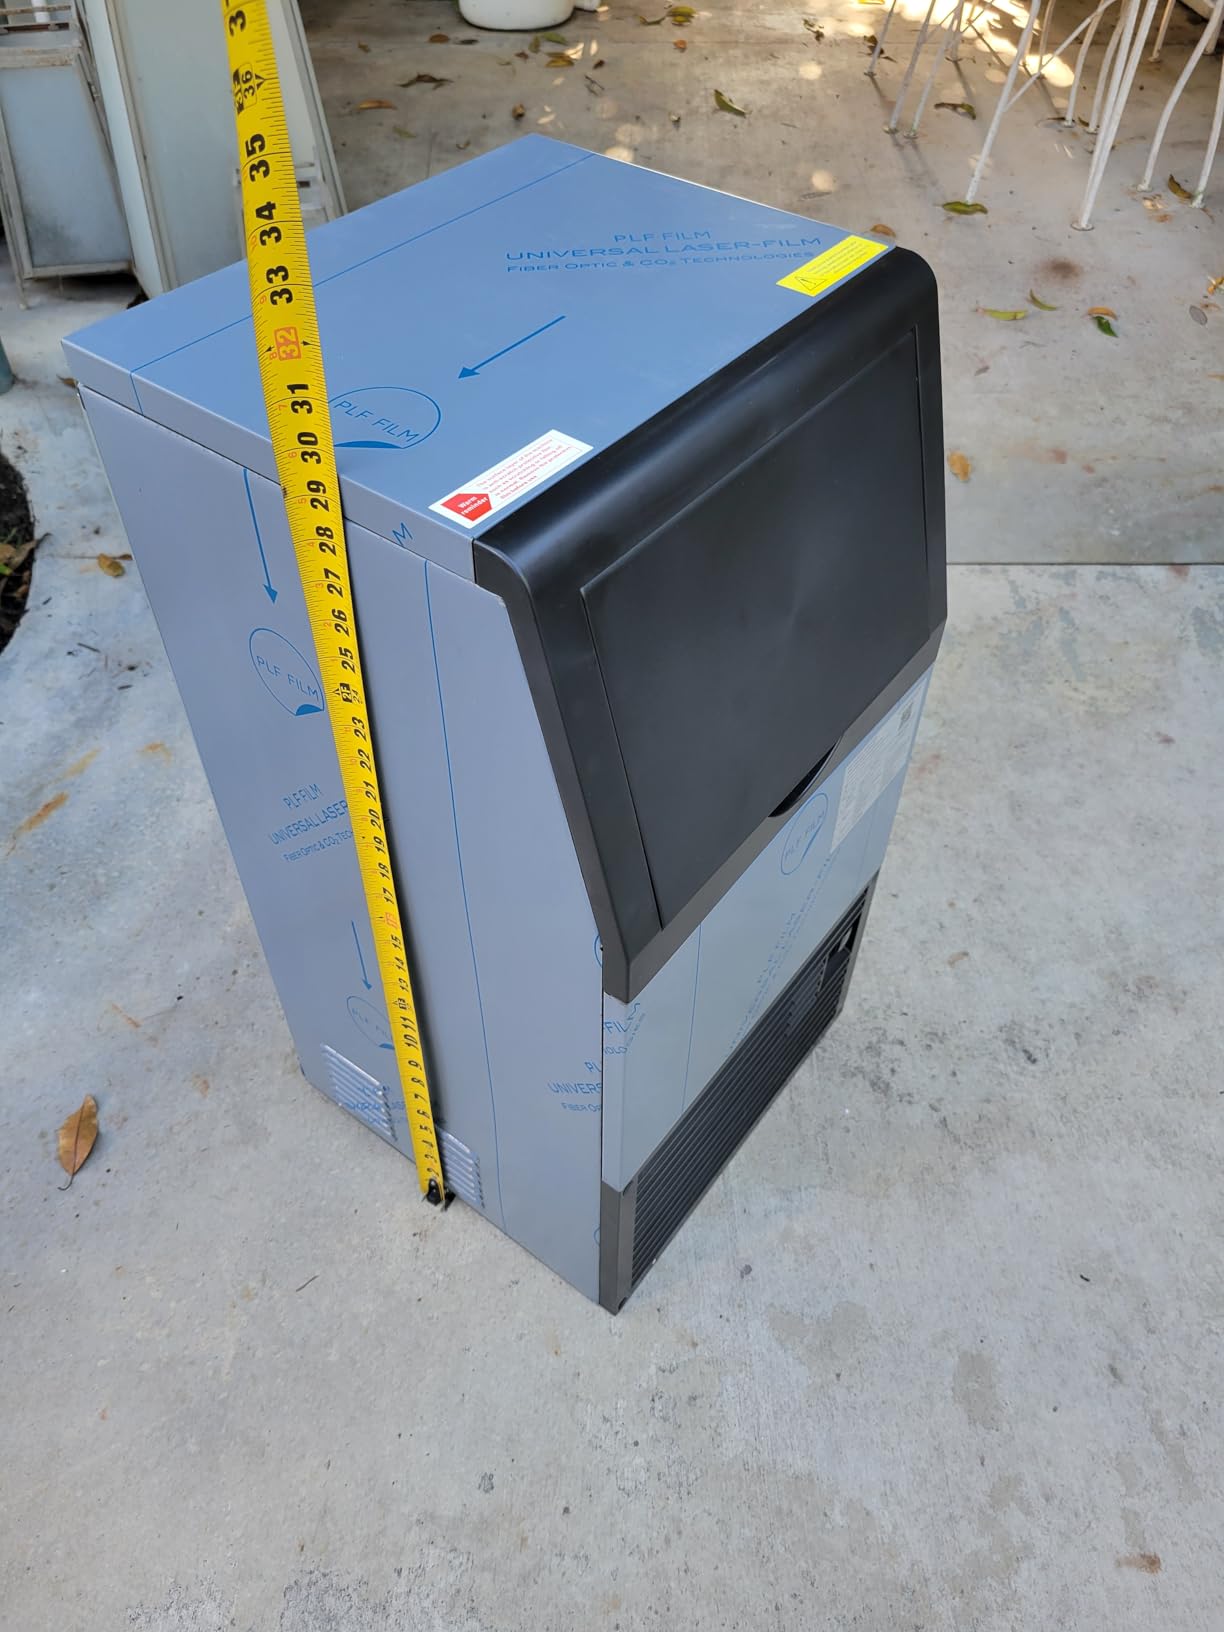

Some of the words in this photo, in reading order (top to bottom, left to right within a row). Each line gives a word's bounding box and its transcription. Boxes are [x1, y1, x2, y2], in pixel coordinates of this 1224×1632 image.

[226, 0, 247, 37] 3
[241, 70, 255, 99] 36
[245, 133, 270, 182] 35
[255, 201, 282, 246] 34
[507, 246, 659, 260] UNIVERSAL
[664, 238, 821, 253] LASER-FILM
[614, 233, 656, 243] PLF
[662, 231, 711, 241] FILM
[507, 264, 559, 273] FIBER
[565, 261, 617, 270] OPTIC
[680, 251, 815, 265] TECHNOLOGIES
[266, 265, 293, 305] 33
[279, 327, 298, 358] 32
[287, 384, 312, 415] 31
[333, 400, 374, 418] PLF
[371, 418, 419, 443] FILM
[297, 431, 321, 465] 30
[307, 480, 330, 512] 29
[457, 496, 477, 508] Warm
[461, 497, 488, 515] reminder
[316, 525, 337, 556] 28
[323, 568, 343, 597] 27
[331, 608, 350, 637] 26
[338, 647, 356, 674] 25
[256, 655, 281, 677] PLF
[287, 673, 319, 701] FILM
[352, 716, 367, 742] 23
[358, 749, 372, 773] 22
[283, 793, 302, 808] PLF
[298, 784, 321, 801] FILM
[363, 781, 377, 803] 21
[271, 816, 319, 845] UNIVERSAL
[368, 808, 382, 831] 20
[373, 836, 386, 854] 19
[378, 862, 390, 880] 18
[383, 887, 394, 904] 17
[391, 934, 402, 951] 15
[400, 1015, 416, 1032] 11
[404, 1034, 419, 1050] 10
[414, 1093, 428, 1104] 7
